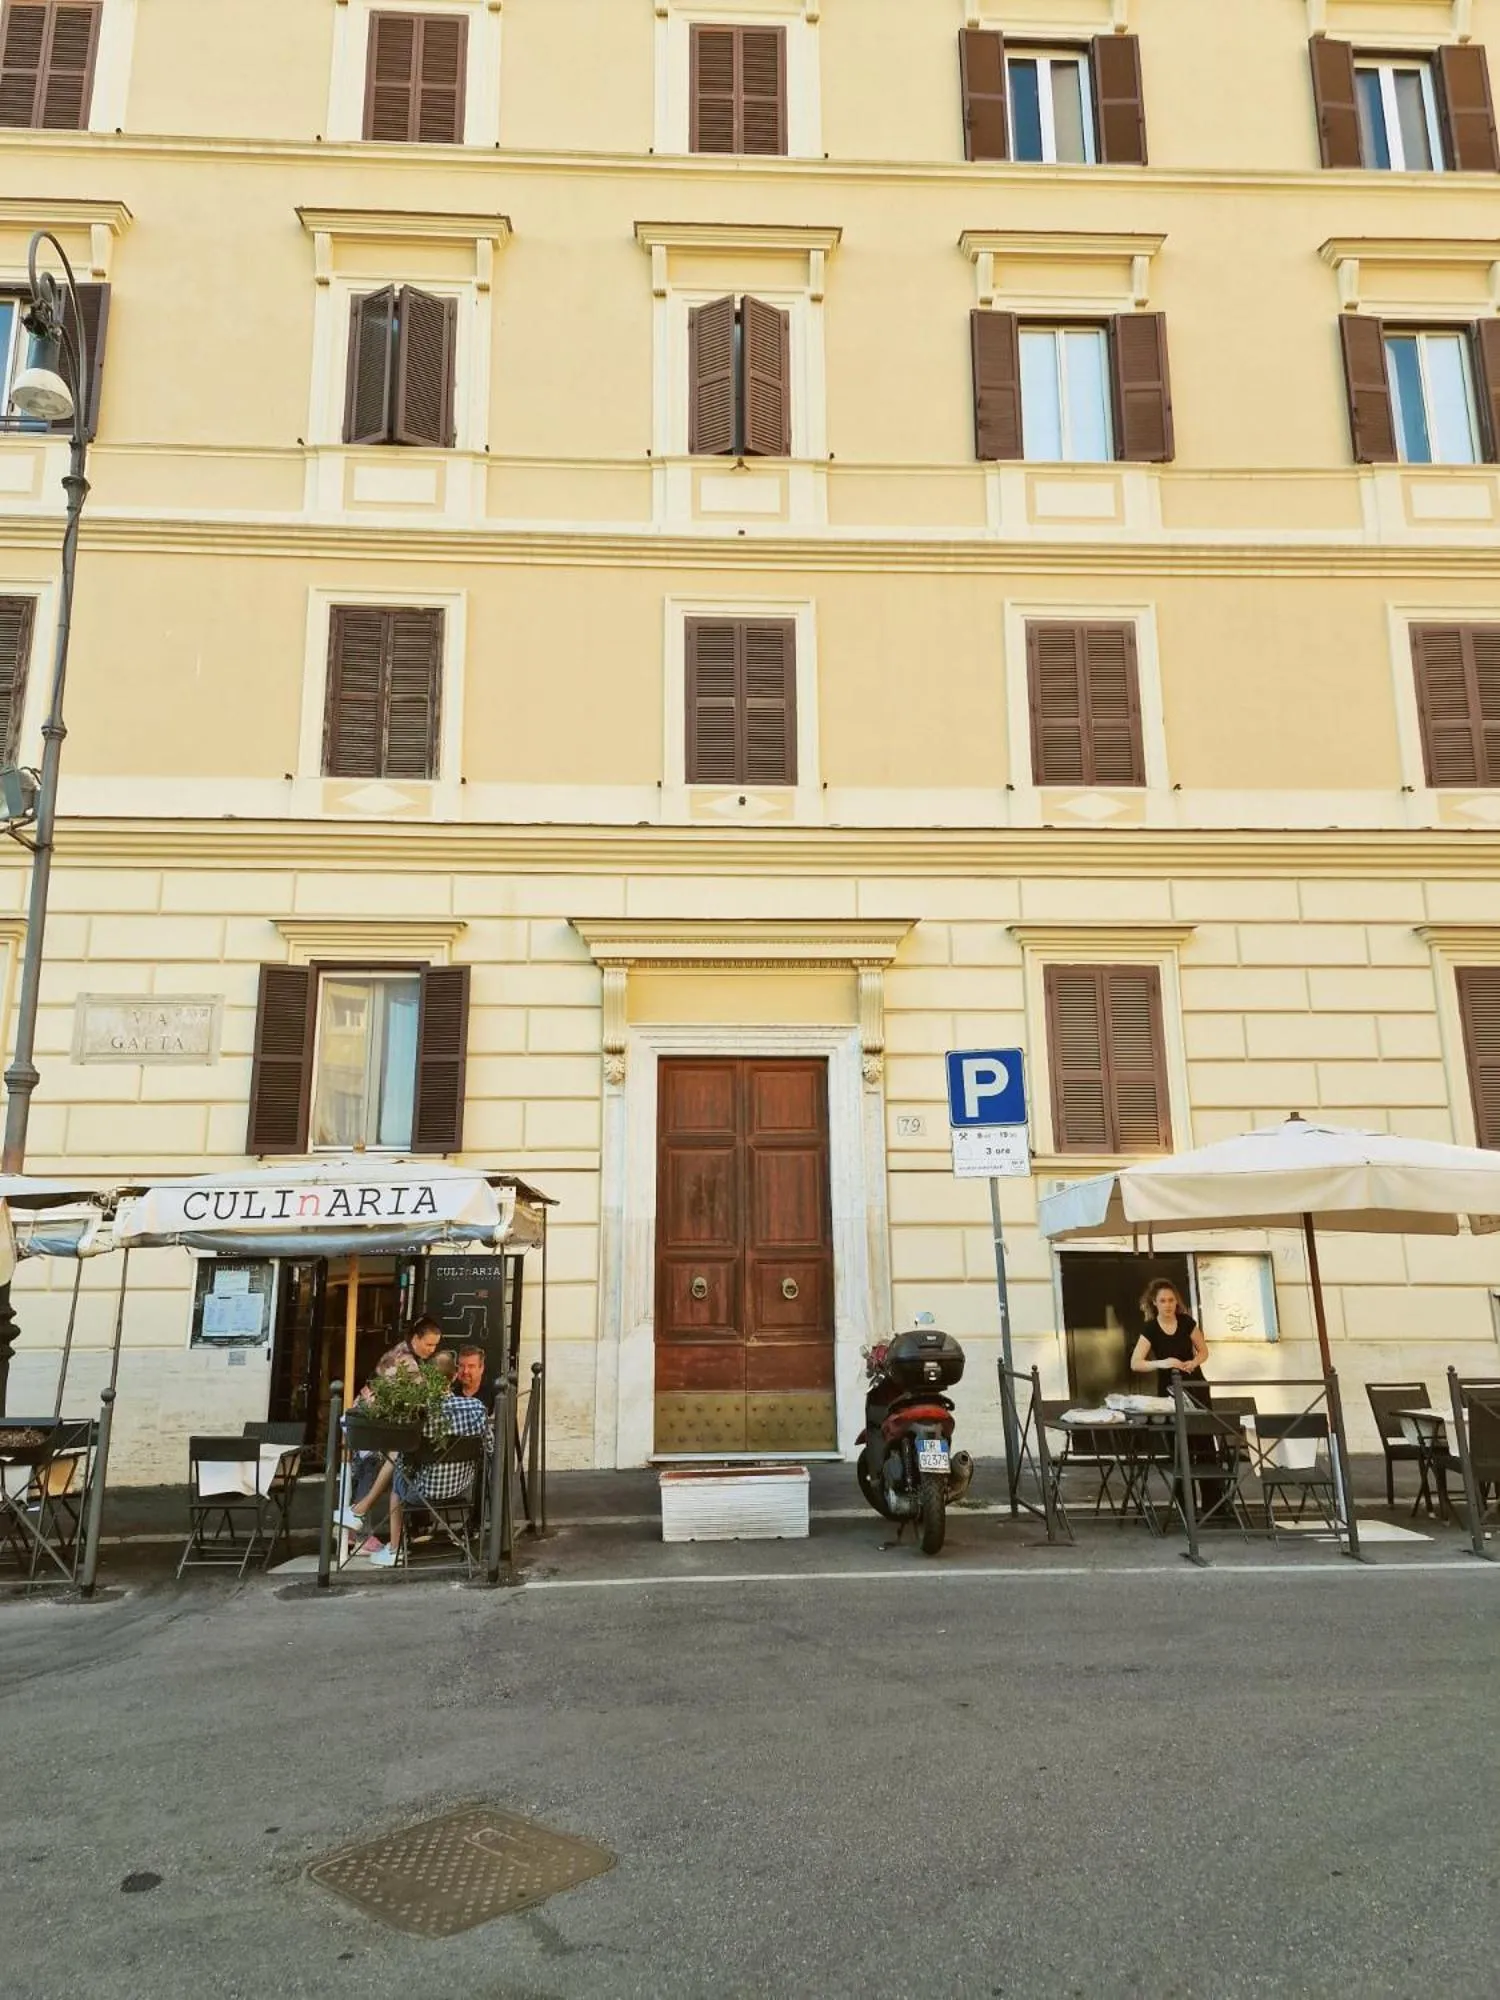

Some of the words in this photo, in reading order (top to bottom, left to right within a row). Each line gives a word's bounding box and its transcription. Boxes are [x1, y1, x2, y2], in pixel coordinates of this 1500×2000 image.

[132, 1011, 168, 1026] VIA
[111, 1036, 184, 1049] GAETA
[962, 1058, 1009, 1118] P
[900, 1118, 921, 1133] 79
[985, 1147, 992, 1155] 3
[183, 1186, 439, 1221] CULInARIA
